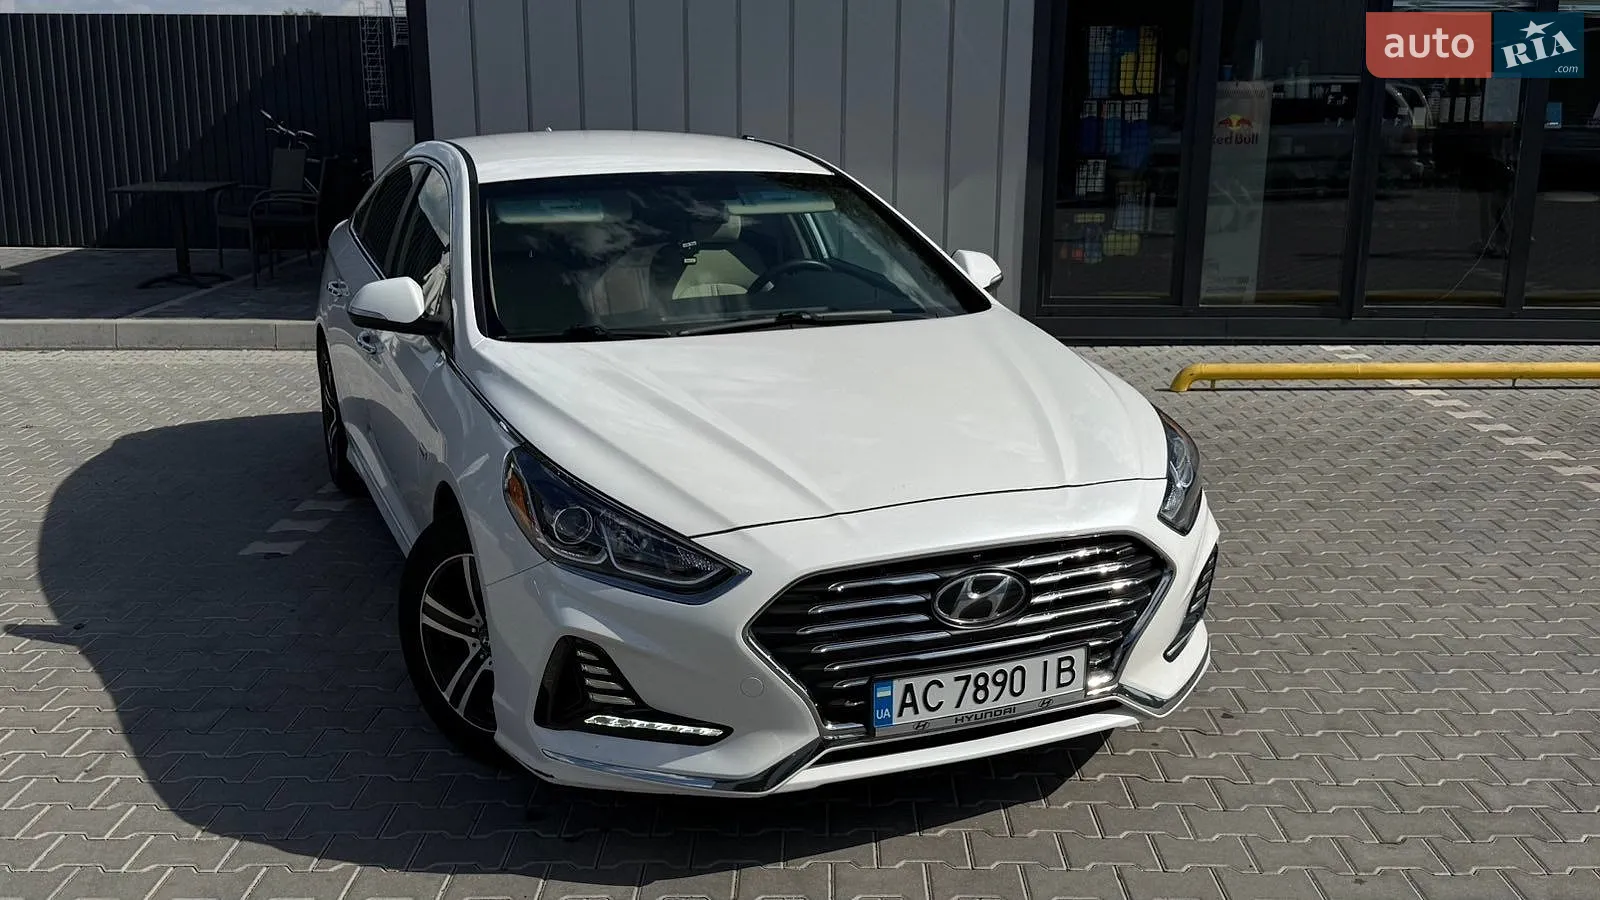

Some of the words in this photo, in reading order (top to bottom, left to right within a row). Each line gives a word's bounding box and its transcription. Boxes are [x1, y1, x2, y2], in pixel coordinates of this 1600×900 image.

[1235, 132, 1259, 145] Bull
[898, 680, 944, 717] AC
[954, 665, 1026, 708] 7890
[1041, 655, 1076, 693] IB
[876, 708, 891, 721] UA
[954, 706, 1016, 724] HYUNDAI
